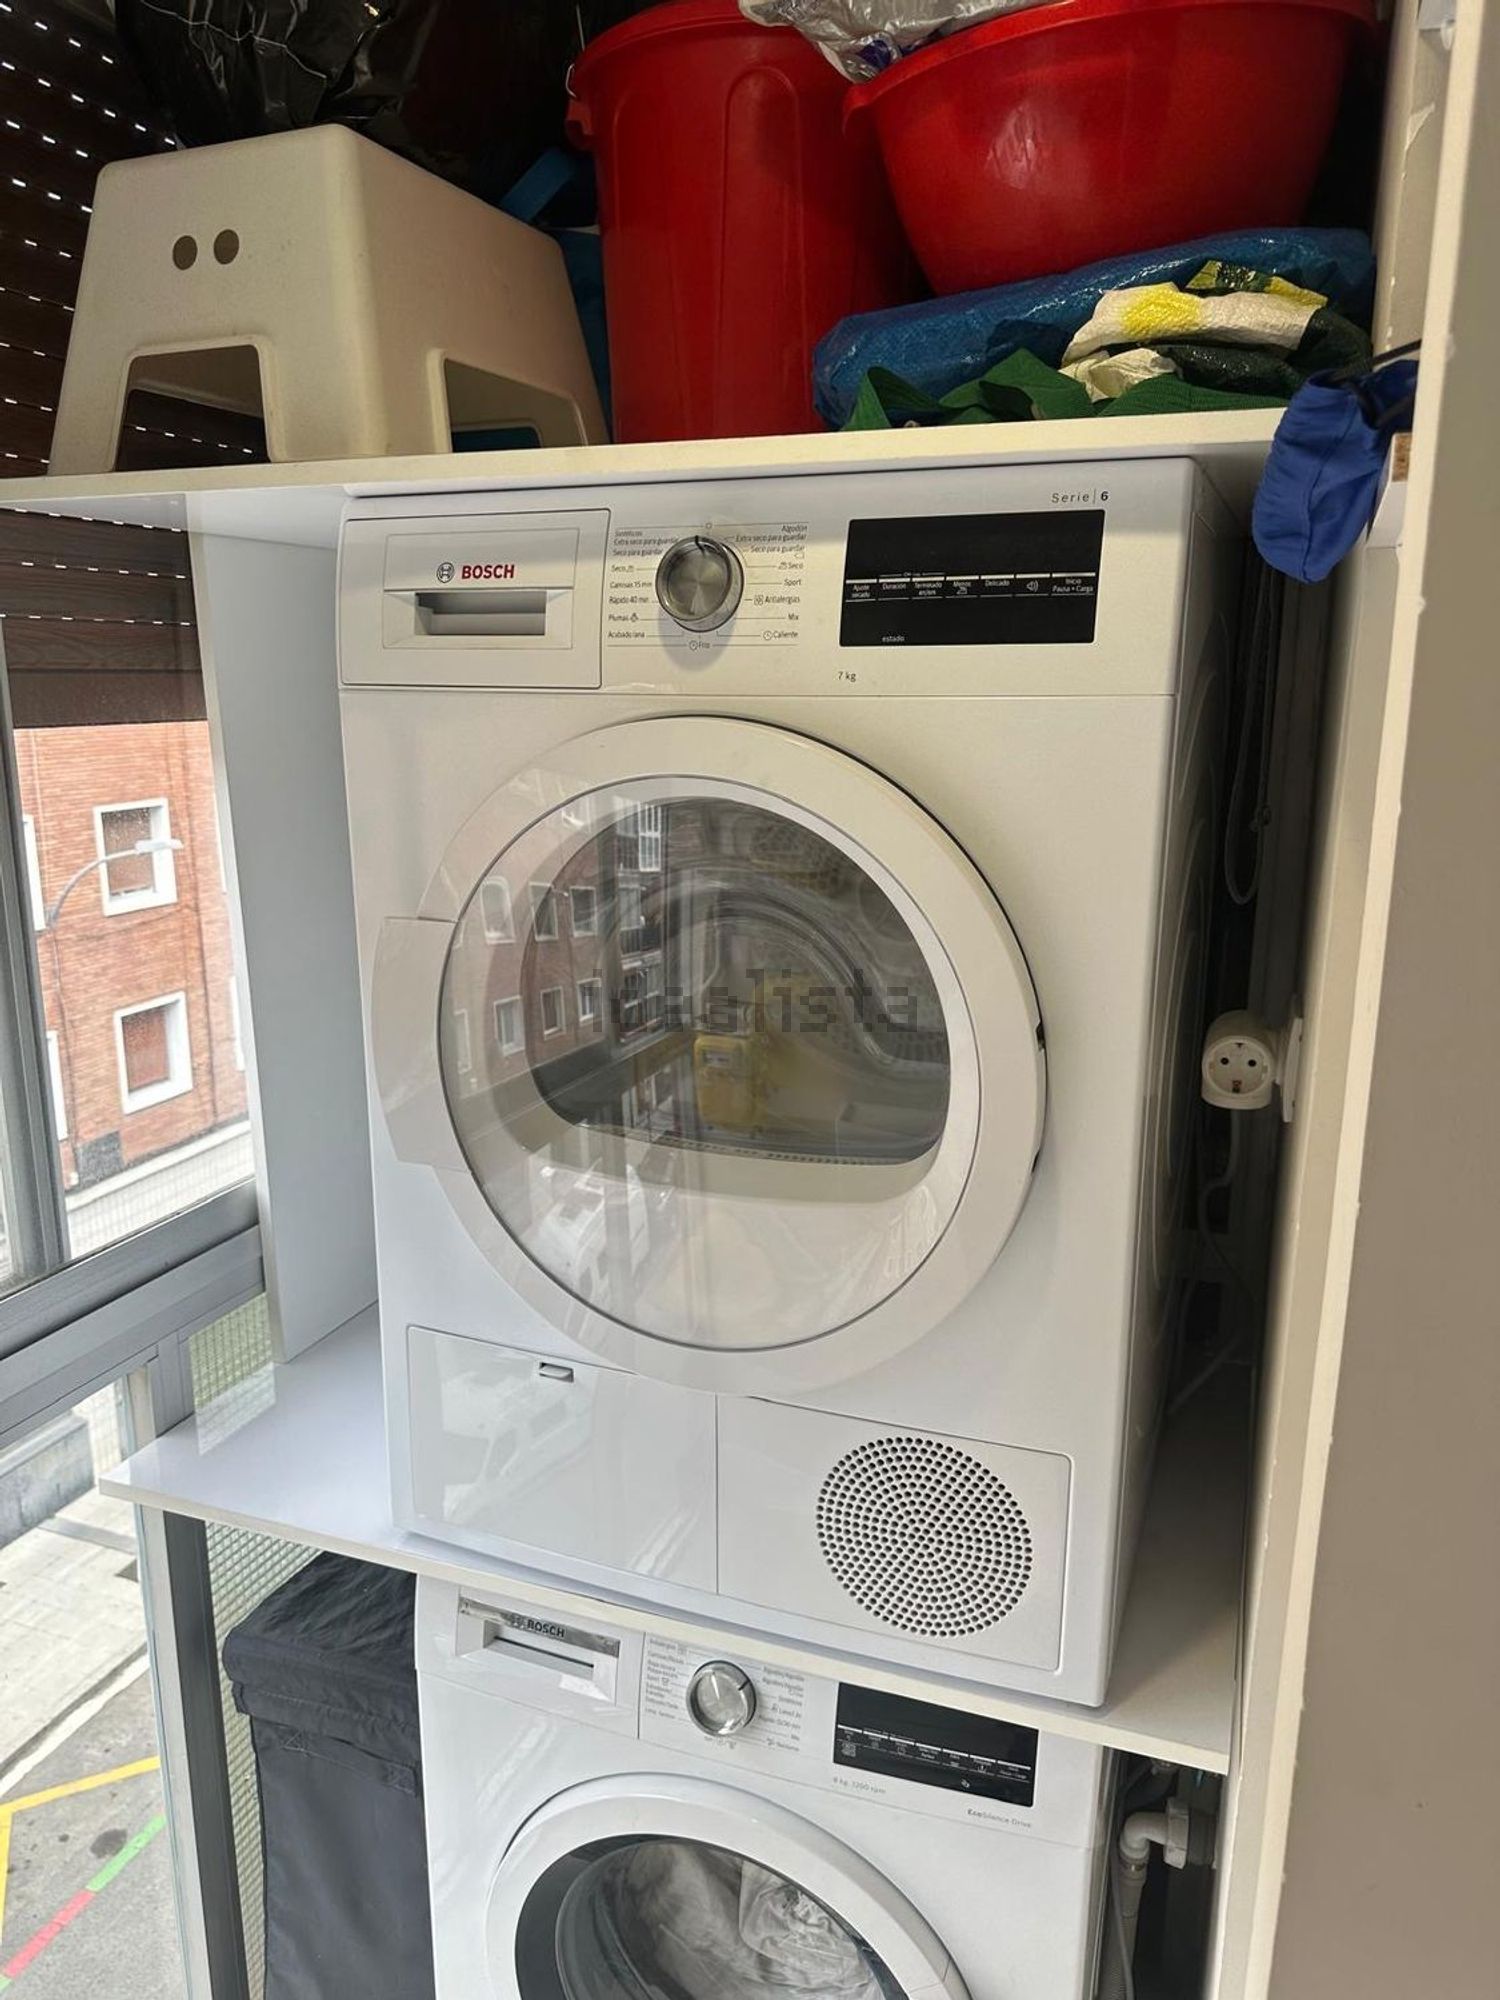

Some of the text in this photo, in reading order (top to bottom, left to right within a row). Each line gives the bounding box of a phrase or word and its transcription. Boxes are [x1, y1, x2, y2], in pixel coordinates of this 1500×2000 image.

[1051, 490, 1109, 503] Serie 6
[461, 564, 515, 579] BOSCH
[838, 671, 856, 683] 7 kg
[527, 1619, 565, 1637] BOSCH
